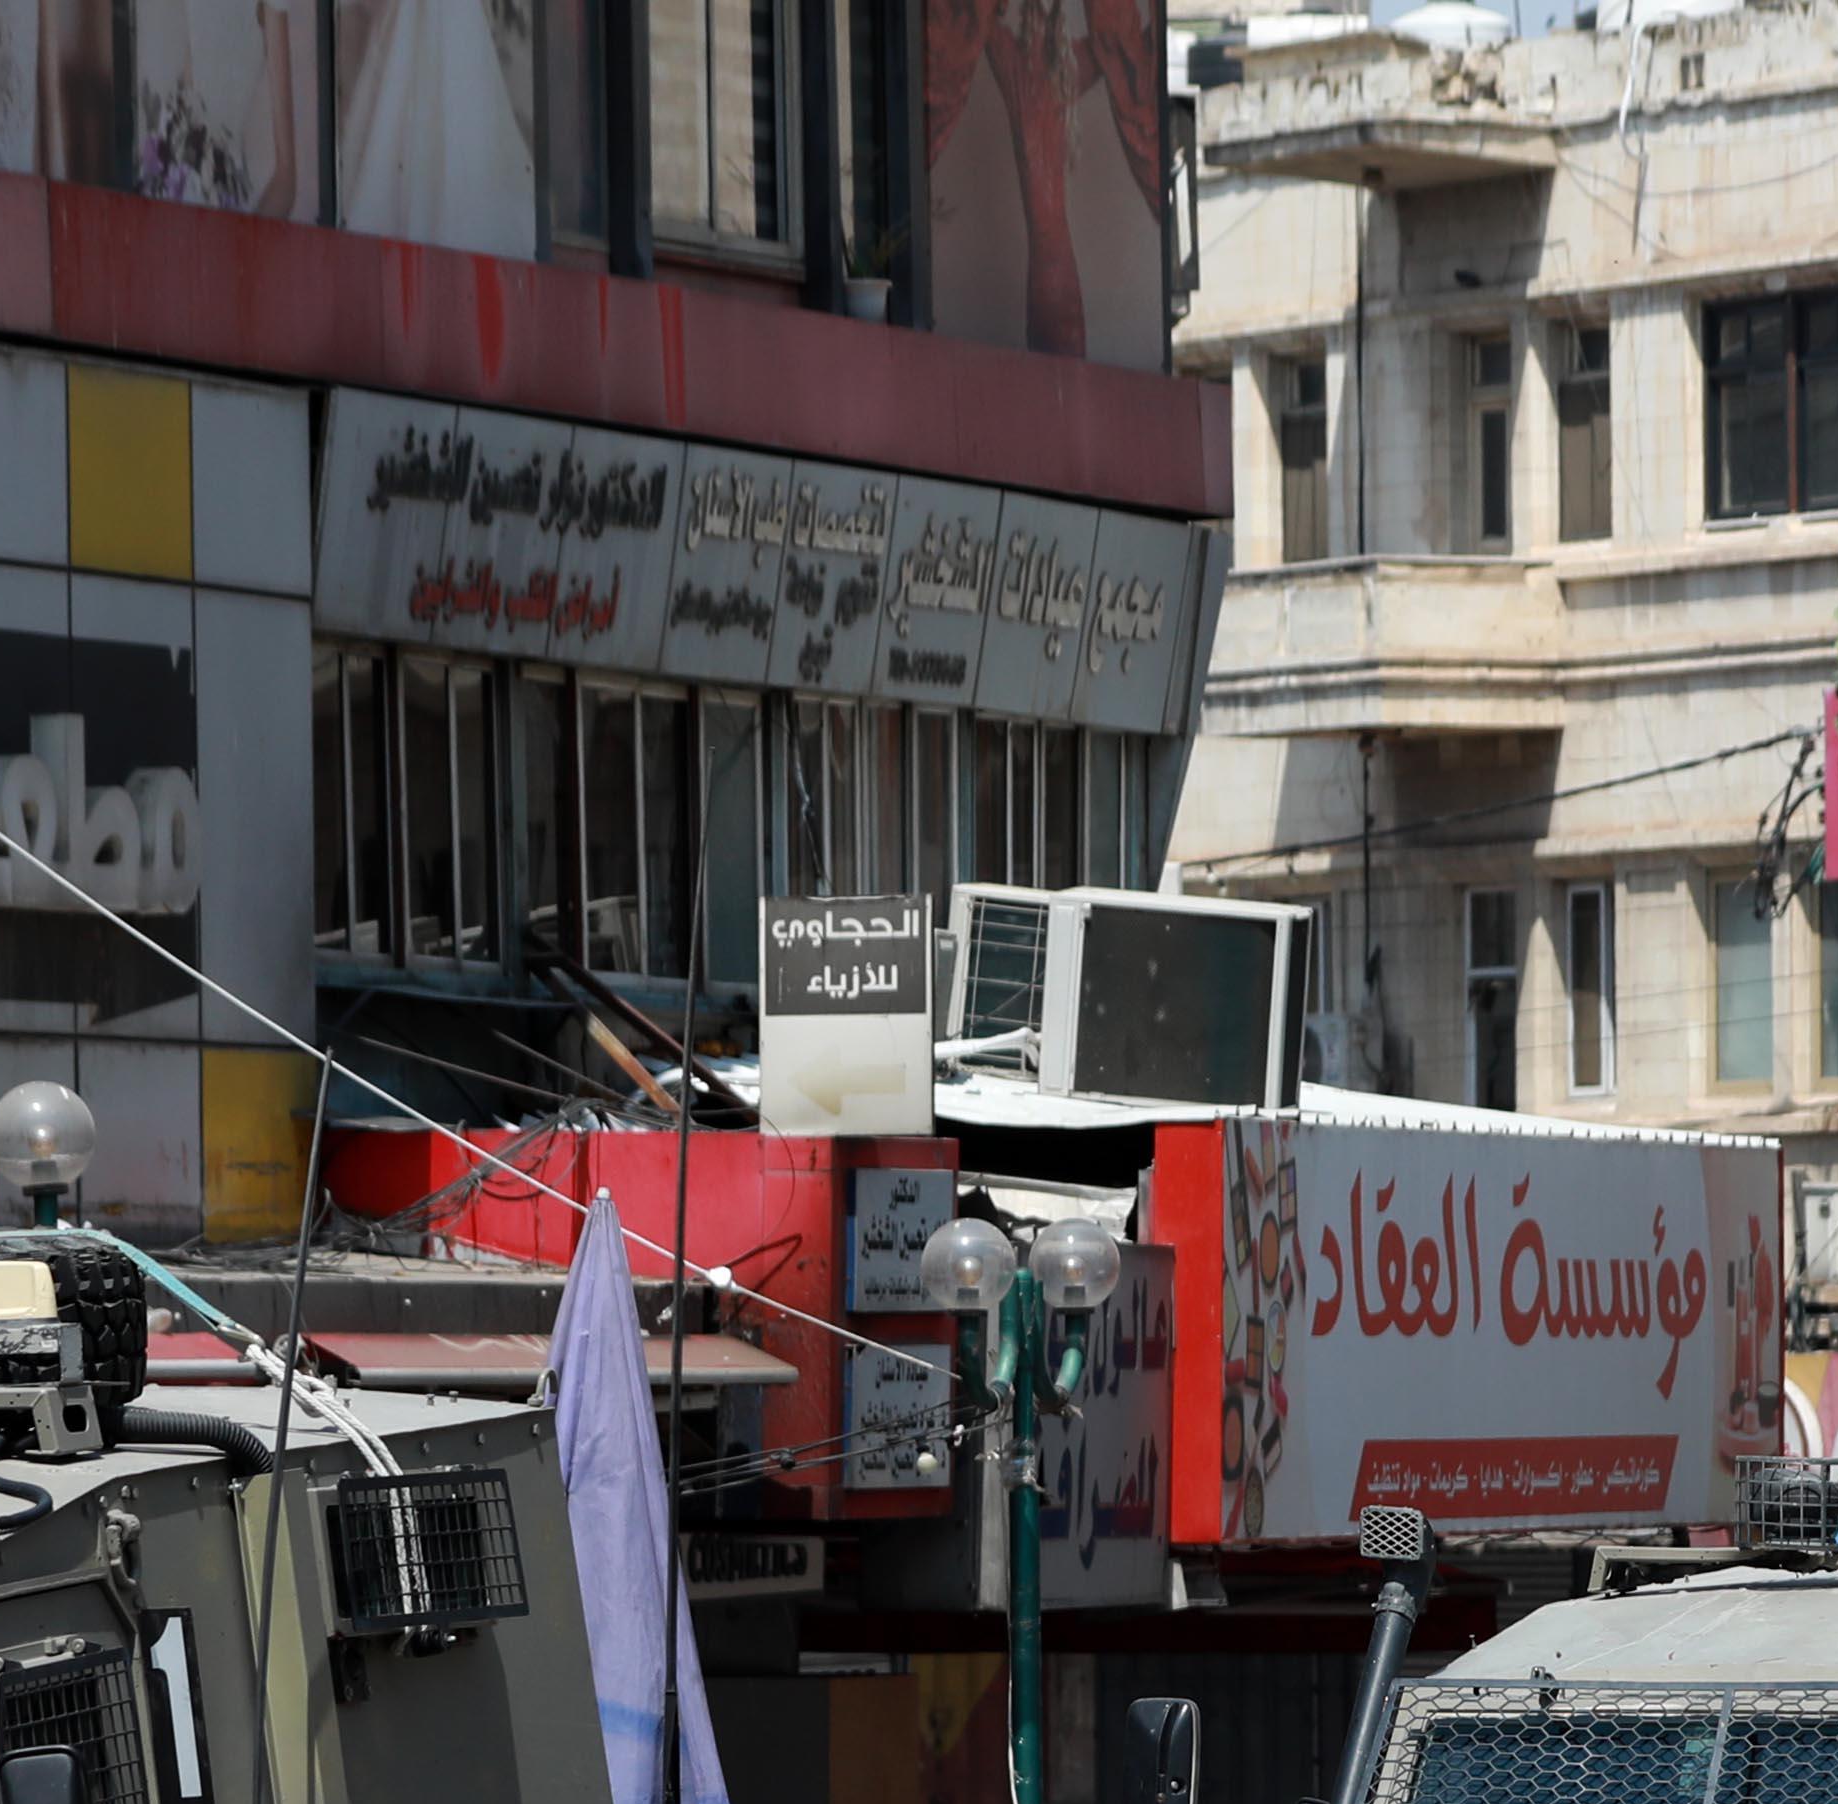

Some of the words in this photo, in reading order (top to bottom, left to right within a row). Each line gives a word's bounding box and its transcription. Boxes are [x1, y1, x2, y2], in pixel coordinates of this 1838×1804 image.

[771, 910, 921, 948] الحجاوي
[806, 963, 900, 997] للأزياء
[1311, 1168, 1482, 1341] العقاد
[1498, 1170, 1708, 1400] مؤسسة
[149, 1616, 203, 1799] 1
